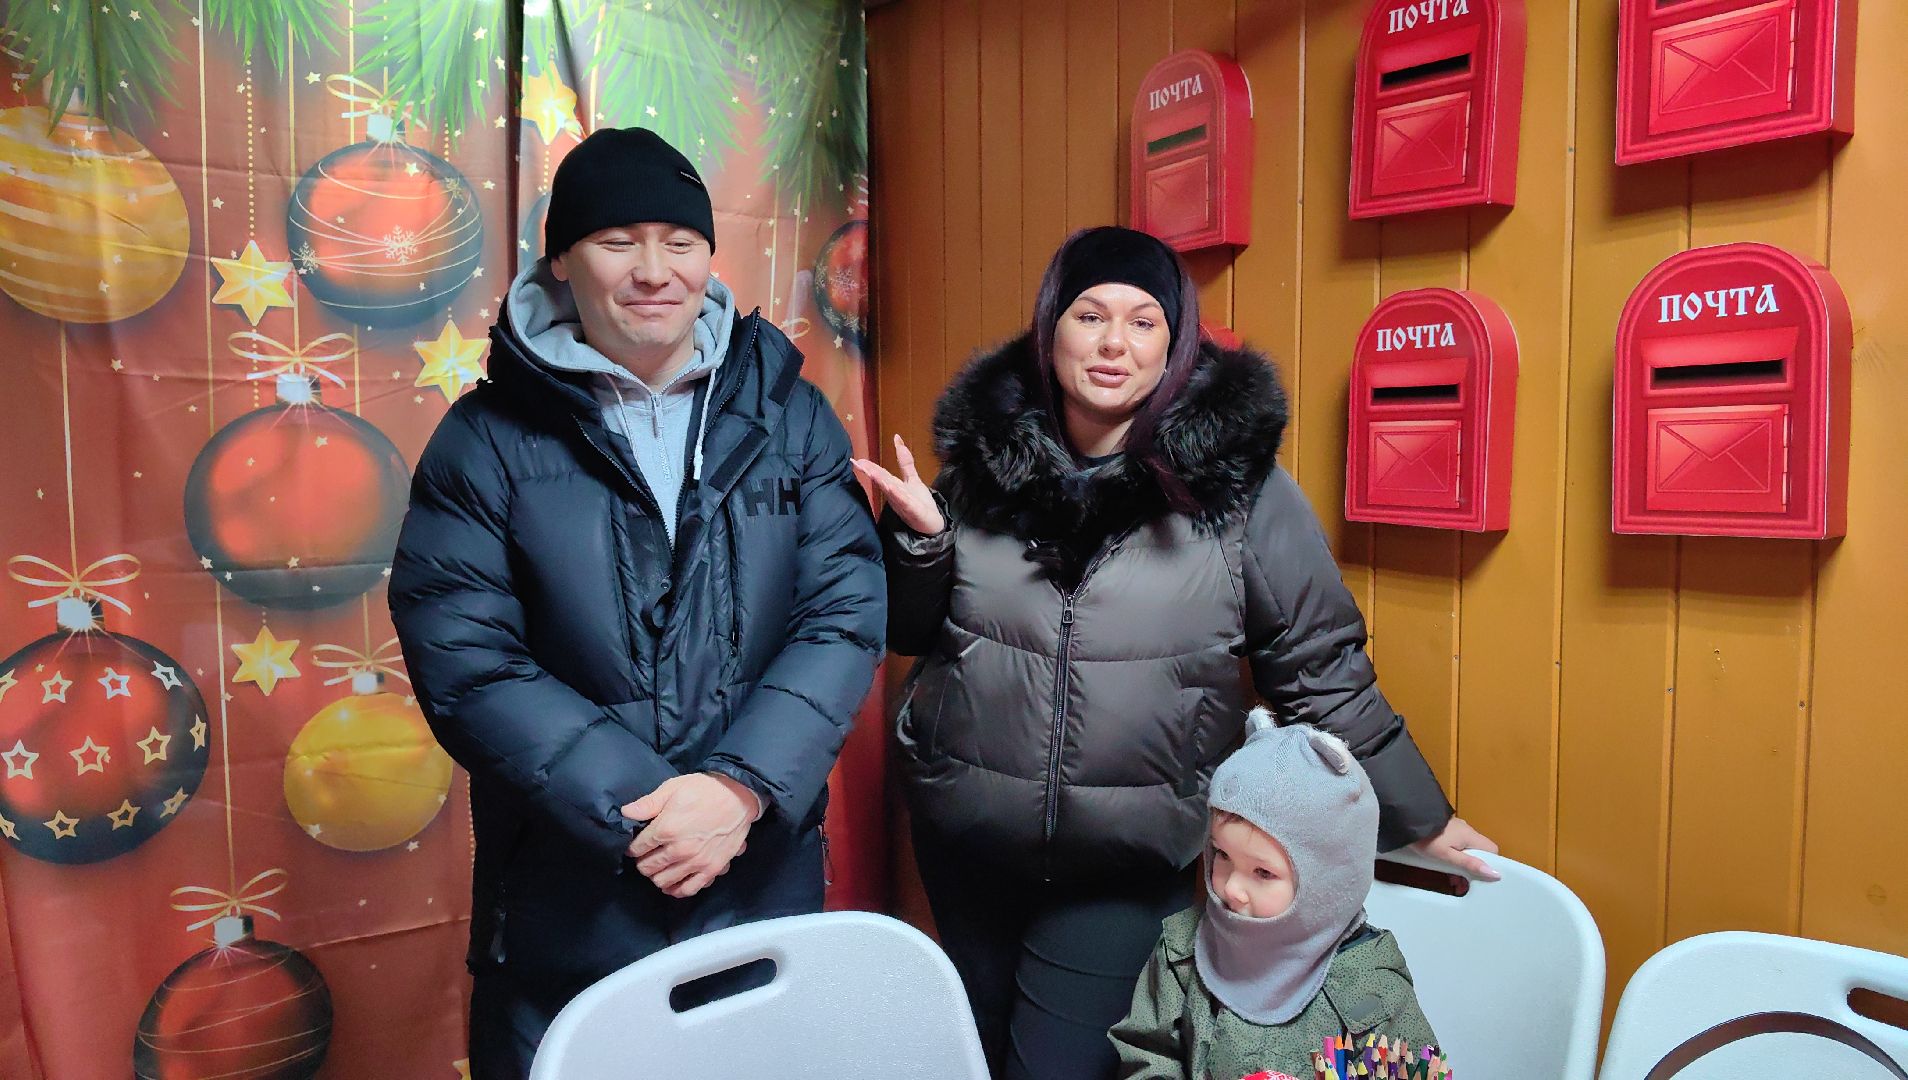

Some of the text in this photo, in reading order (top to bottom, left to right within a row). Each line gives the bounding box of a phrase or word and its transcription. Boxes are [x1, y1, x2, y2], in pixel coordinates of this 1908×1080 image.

[1387, 0, 1470, 34] ПОЧТА
[1149, 73, 1204, 112] ПОЧТА
[1657, 283, 1780, 323] ПОЧТА
[1376, 322, 1457, 352] ПОЧТА
[740, 477, 801, 516] HH
